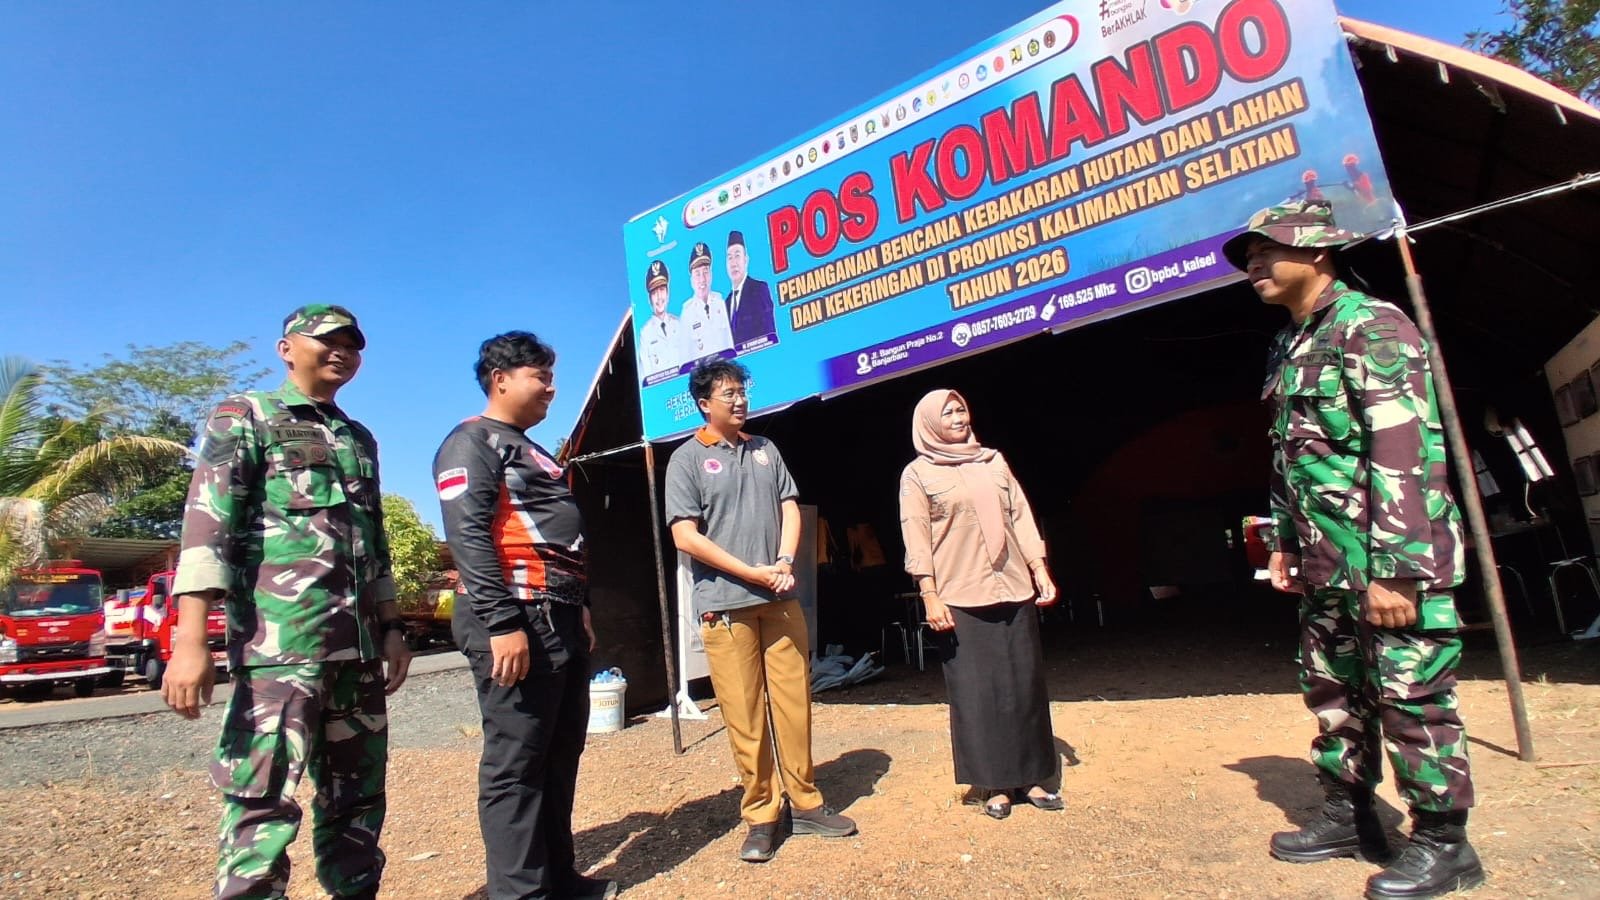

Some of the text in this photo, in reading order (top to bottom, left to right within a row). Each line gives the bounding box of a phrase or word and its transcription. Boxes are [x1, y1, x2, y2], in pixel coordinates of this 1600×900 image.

[1101, 8, 1147, 38] BerAKHLAK
[768, 0, 1291, 273] POS KOMANDO
[778, 82, 1305, 303] PENANGANAN BENCANA KEBAKARAN HUTAN DAN LAHAN
[791, 127, 1297, 329] DAN KEKERINGAN DI PROVINSI KALIMANTAN SELATAN
[950, 249, 1067, 308] TAHUN 2026
[1151, 252, 1217, 283] bpbd_kalsel
[1058, 283, 1117, 310] 169.525 Mhz
[971, 305, 1037, 337] 0857-7603-2729
[871, 351, 909, 368] Banjarbaru
[879, 344, 906, 357] Bangun
[906, 338, 925, 350] Praja
[925, 331, 944, 343] No.2
